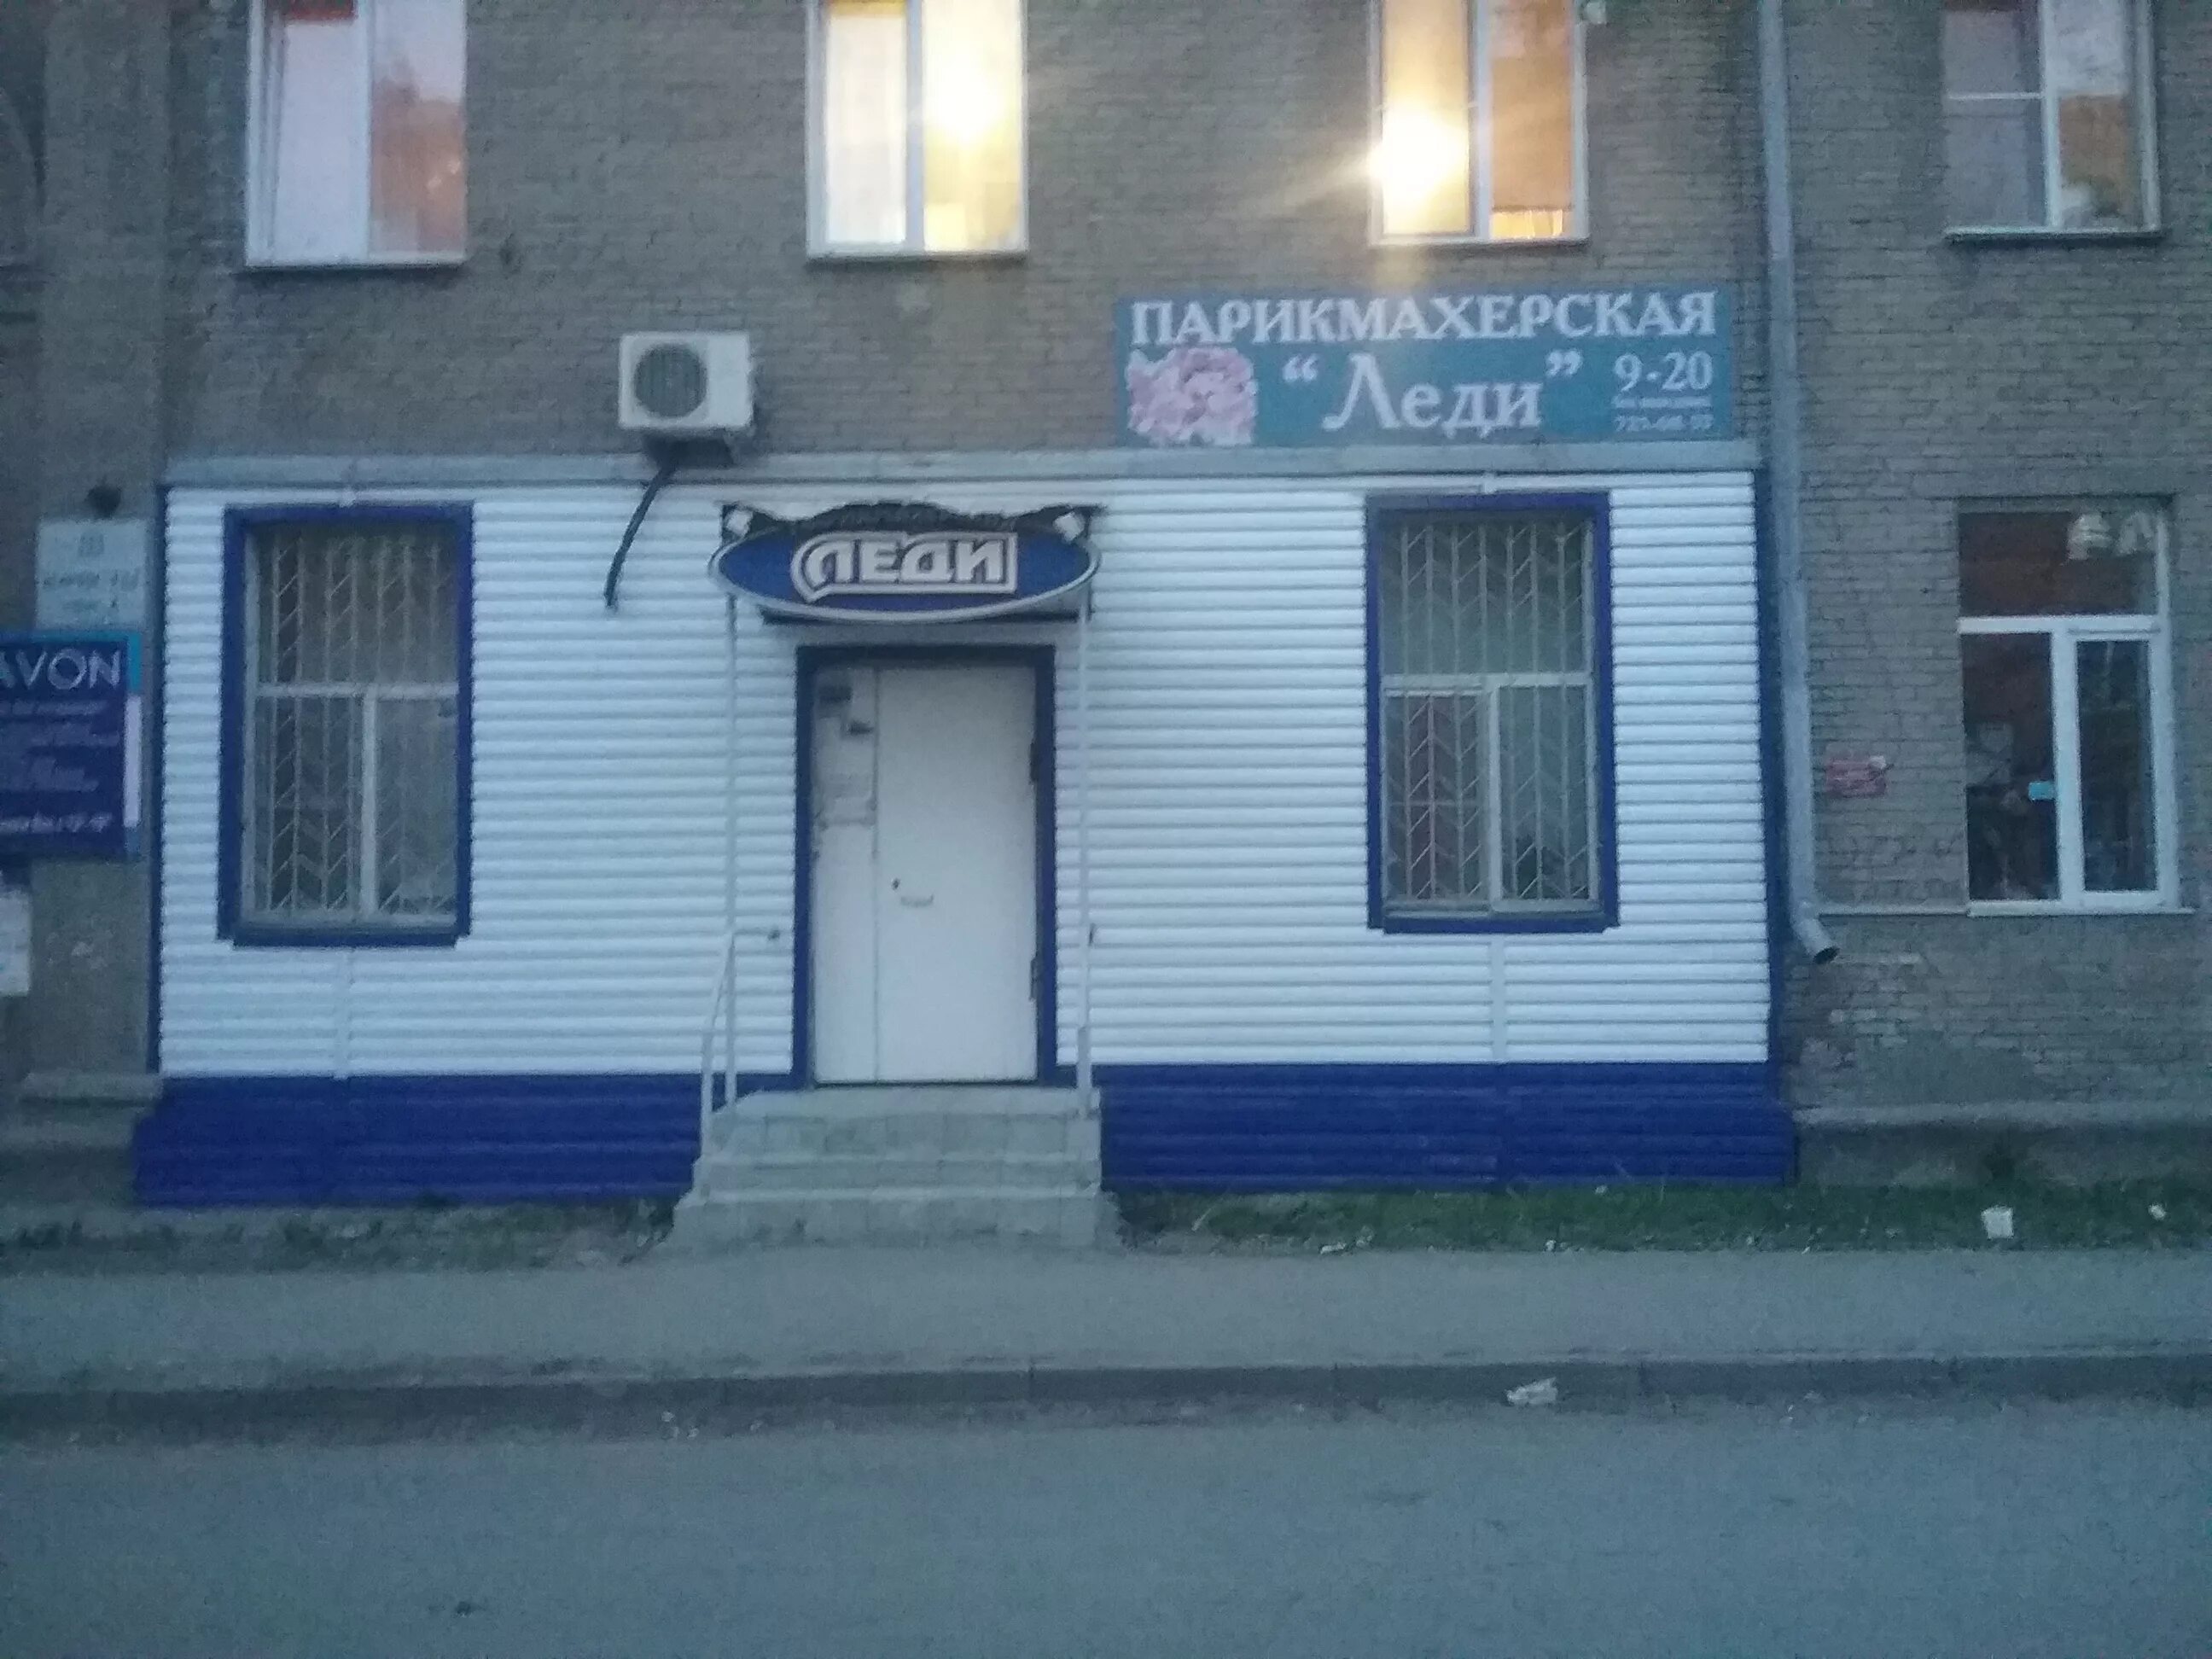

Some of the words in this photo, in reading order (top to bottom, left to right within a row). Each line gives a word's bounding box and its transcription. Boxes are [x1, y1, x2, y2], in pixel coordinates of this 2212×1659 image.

[1131, 292, 1718, 344] ПАРИКМАХЕРСКАЯ
[1613, 351, 1714, 391] 9-20
[799, 535, 1009, 592] ЛЕДИ
